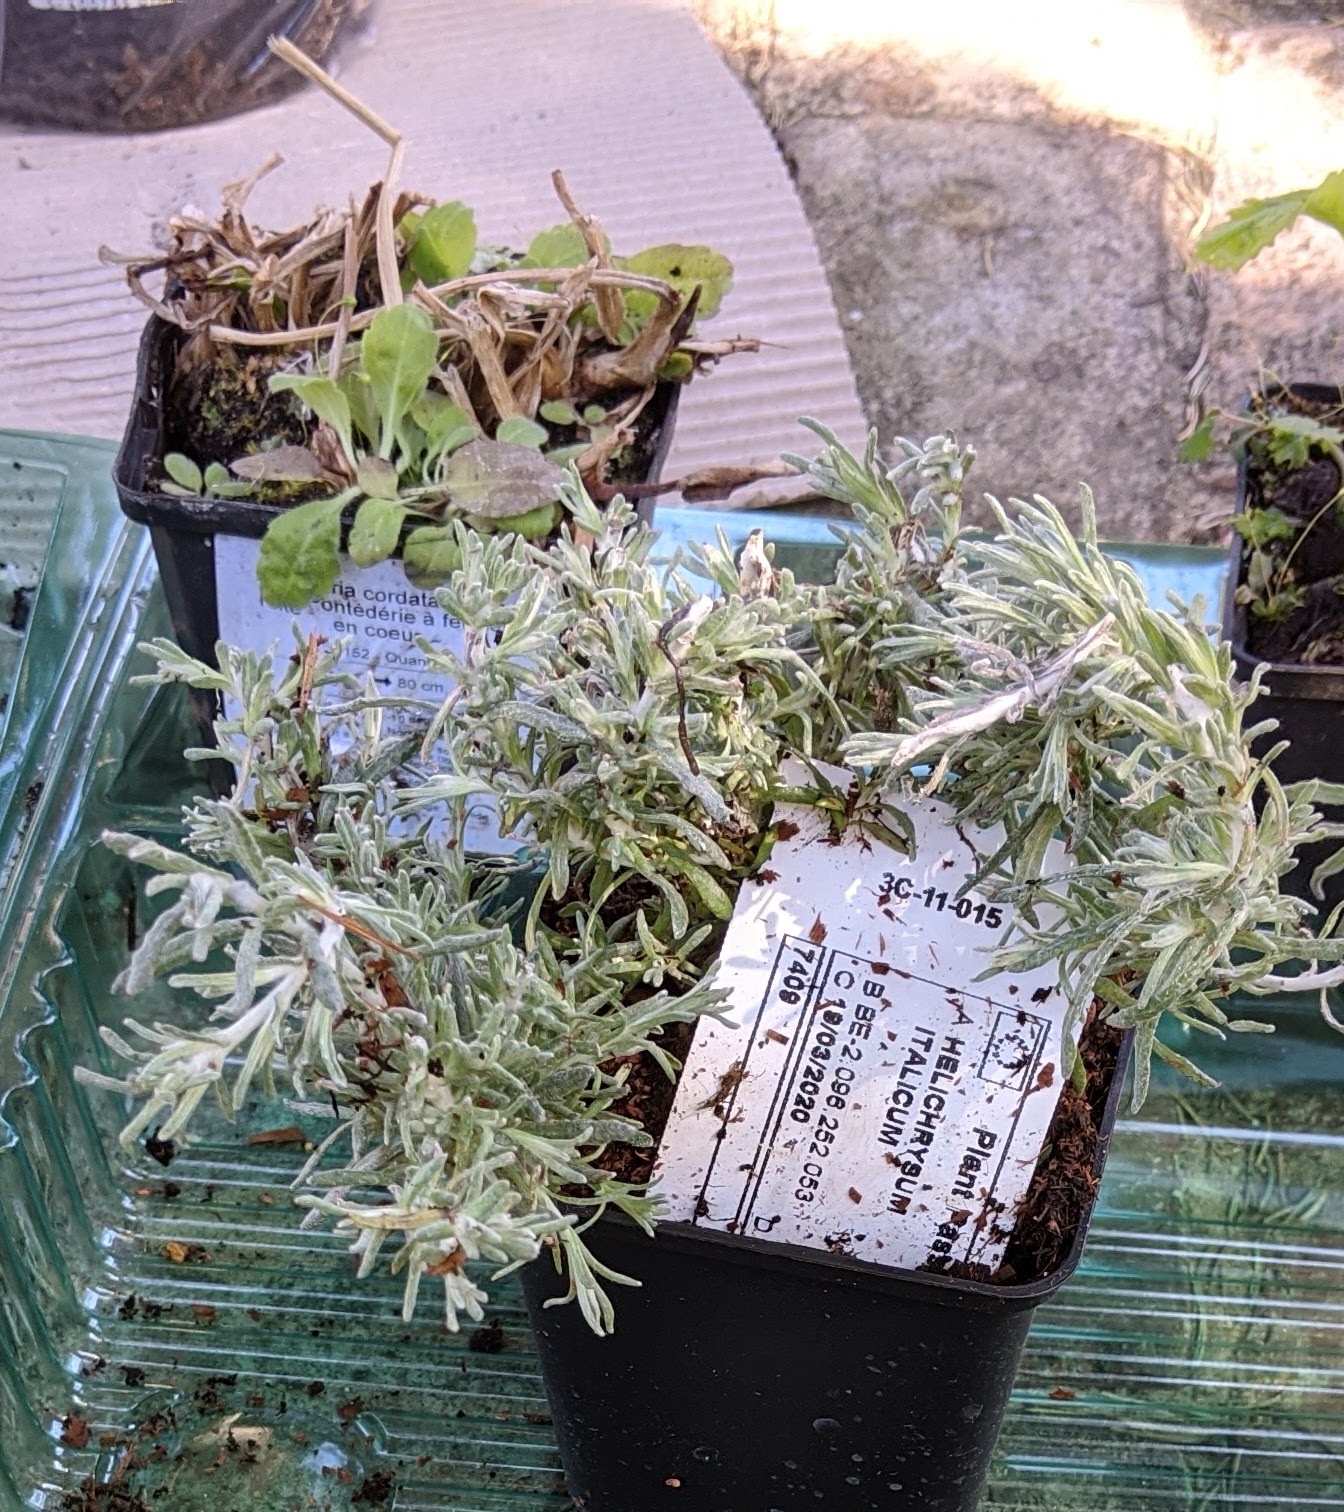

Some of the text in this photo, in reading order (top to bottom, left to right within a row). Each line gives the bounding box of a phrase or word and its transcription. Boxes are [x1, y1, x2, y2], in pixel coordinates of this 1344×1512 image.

[363, 588, 439, 608] cordata
[333, 620, 357, 635] en
[398, 678, 443, 693] 80 cm
[879, 872, 1003, 929] 3C-11-015
[834, 970, 855, 990] C
[863, 979, 885, 998] B
[877, 1026, 936, 1147] ITALICUM
[886, 1036, 965, 1215] HELICHRYSUM
[952, 1126, 998, 1200] Plant
